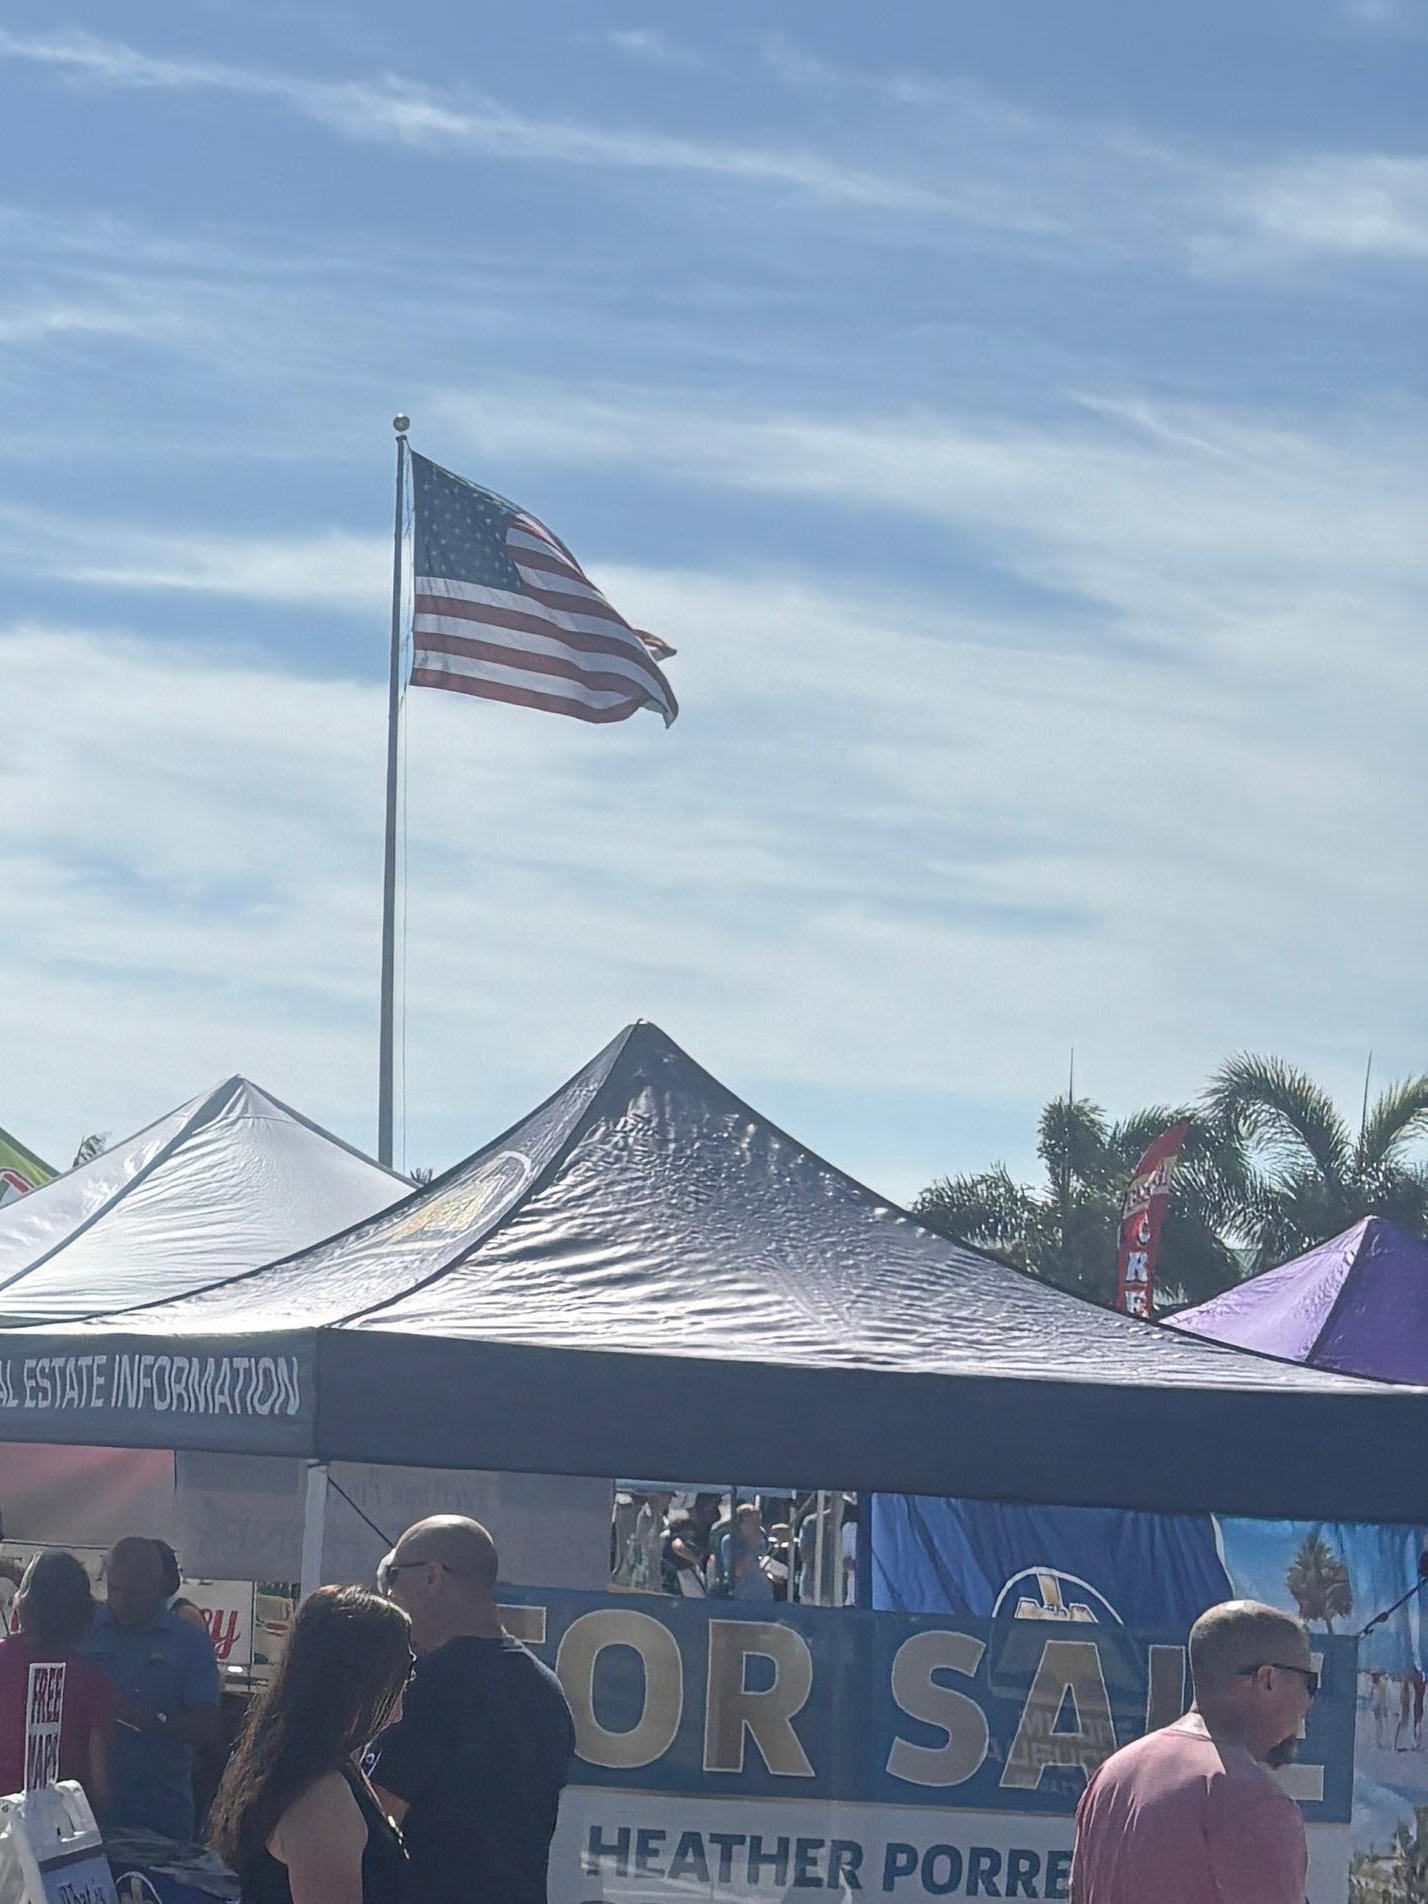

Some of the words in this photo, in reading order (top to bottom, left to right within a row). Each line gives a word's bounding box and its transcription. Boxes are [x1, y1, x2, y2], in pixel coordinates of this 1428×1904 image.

[23, 1354, 108, 1409] ESTATE
[110, 1353, 300, 1416] INFORMATION
[496, 1603, 816, 1779] OR
[587, 1825, 863, 1892] HEATHER
